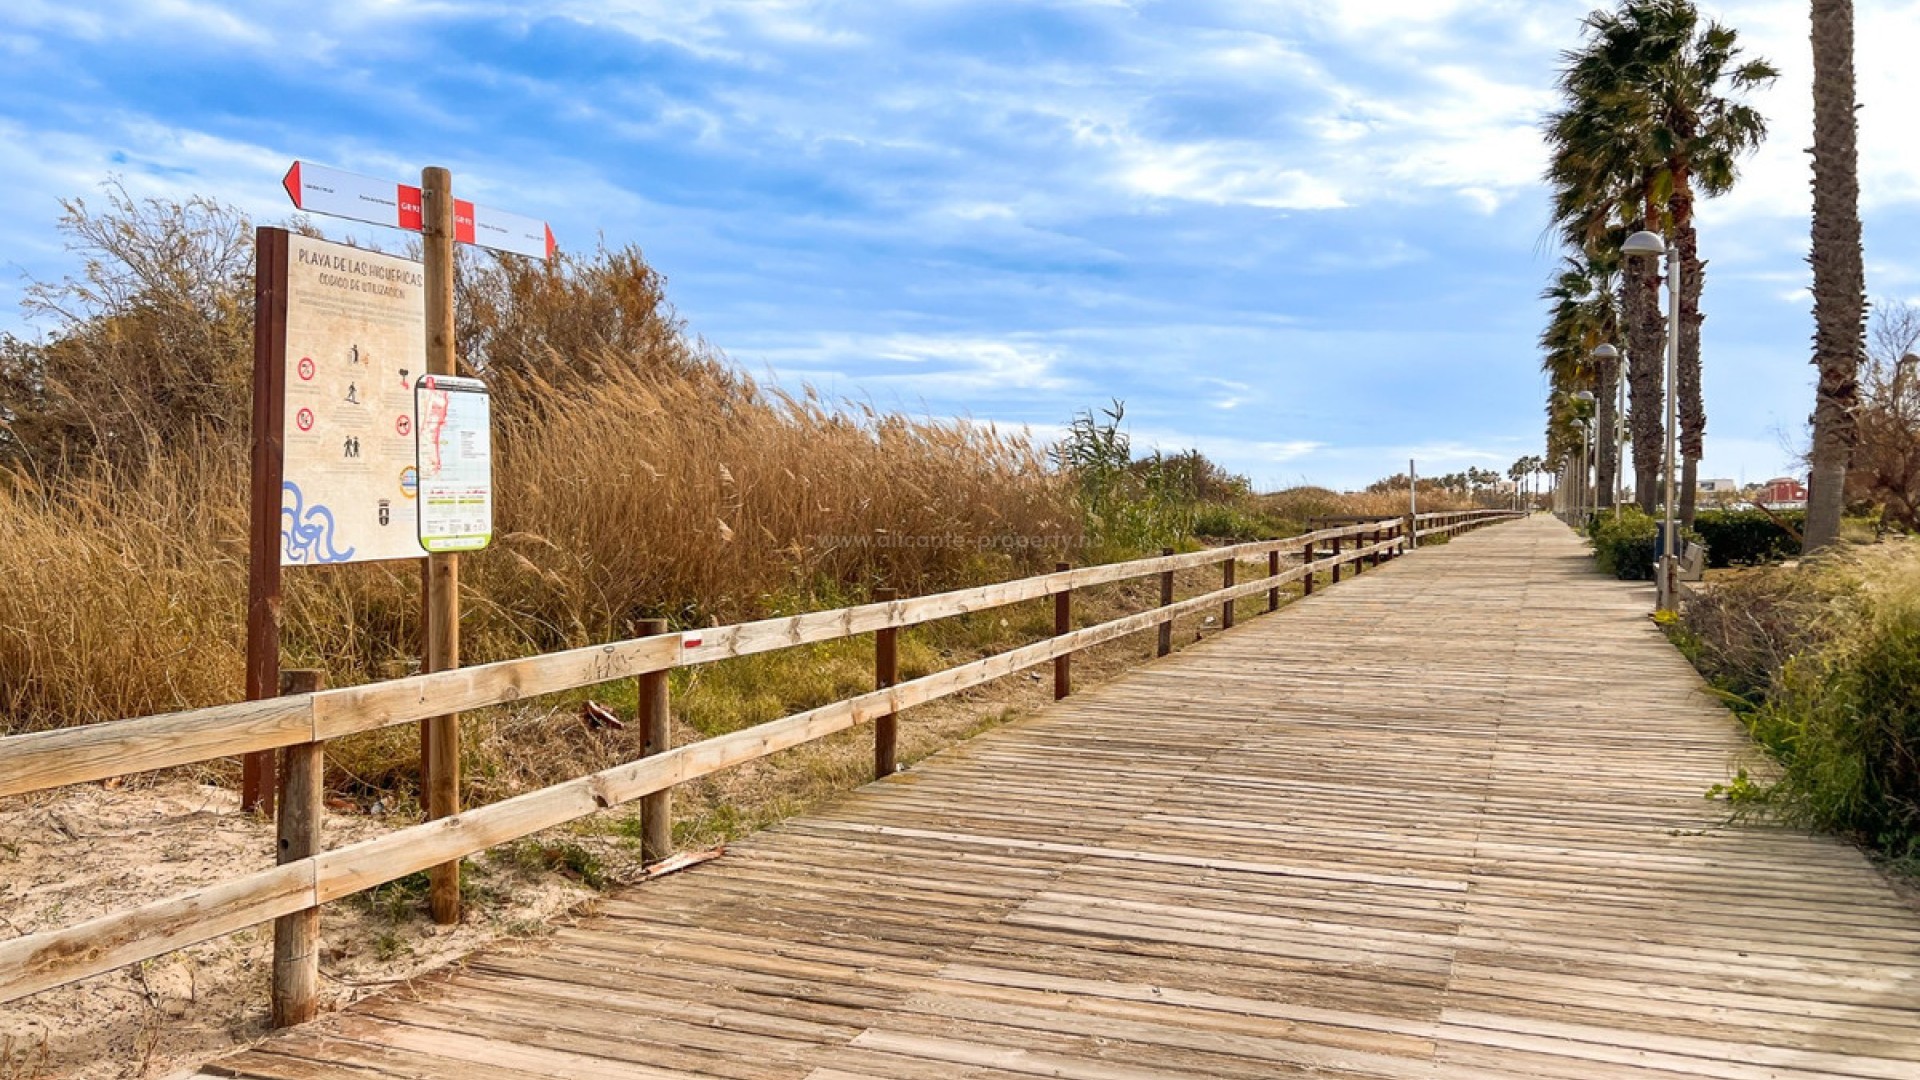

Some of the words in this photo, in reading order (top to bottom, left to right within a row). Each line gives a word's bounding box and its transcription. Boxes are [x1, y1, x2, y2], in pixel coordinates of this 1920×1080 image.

[298, 248, 331, 268] PLAYA
[334, 256, 346, 272] DE
[348, 260, 367, 277] LAS
[369, 265, 423, 287] HIGUERICAS
[350, 278, 360, 291] DE
